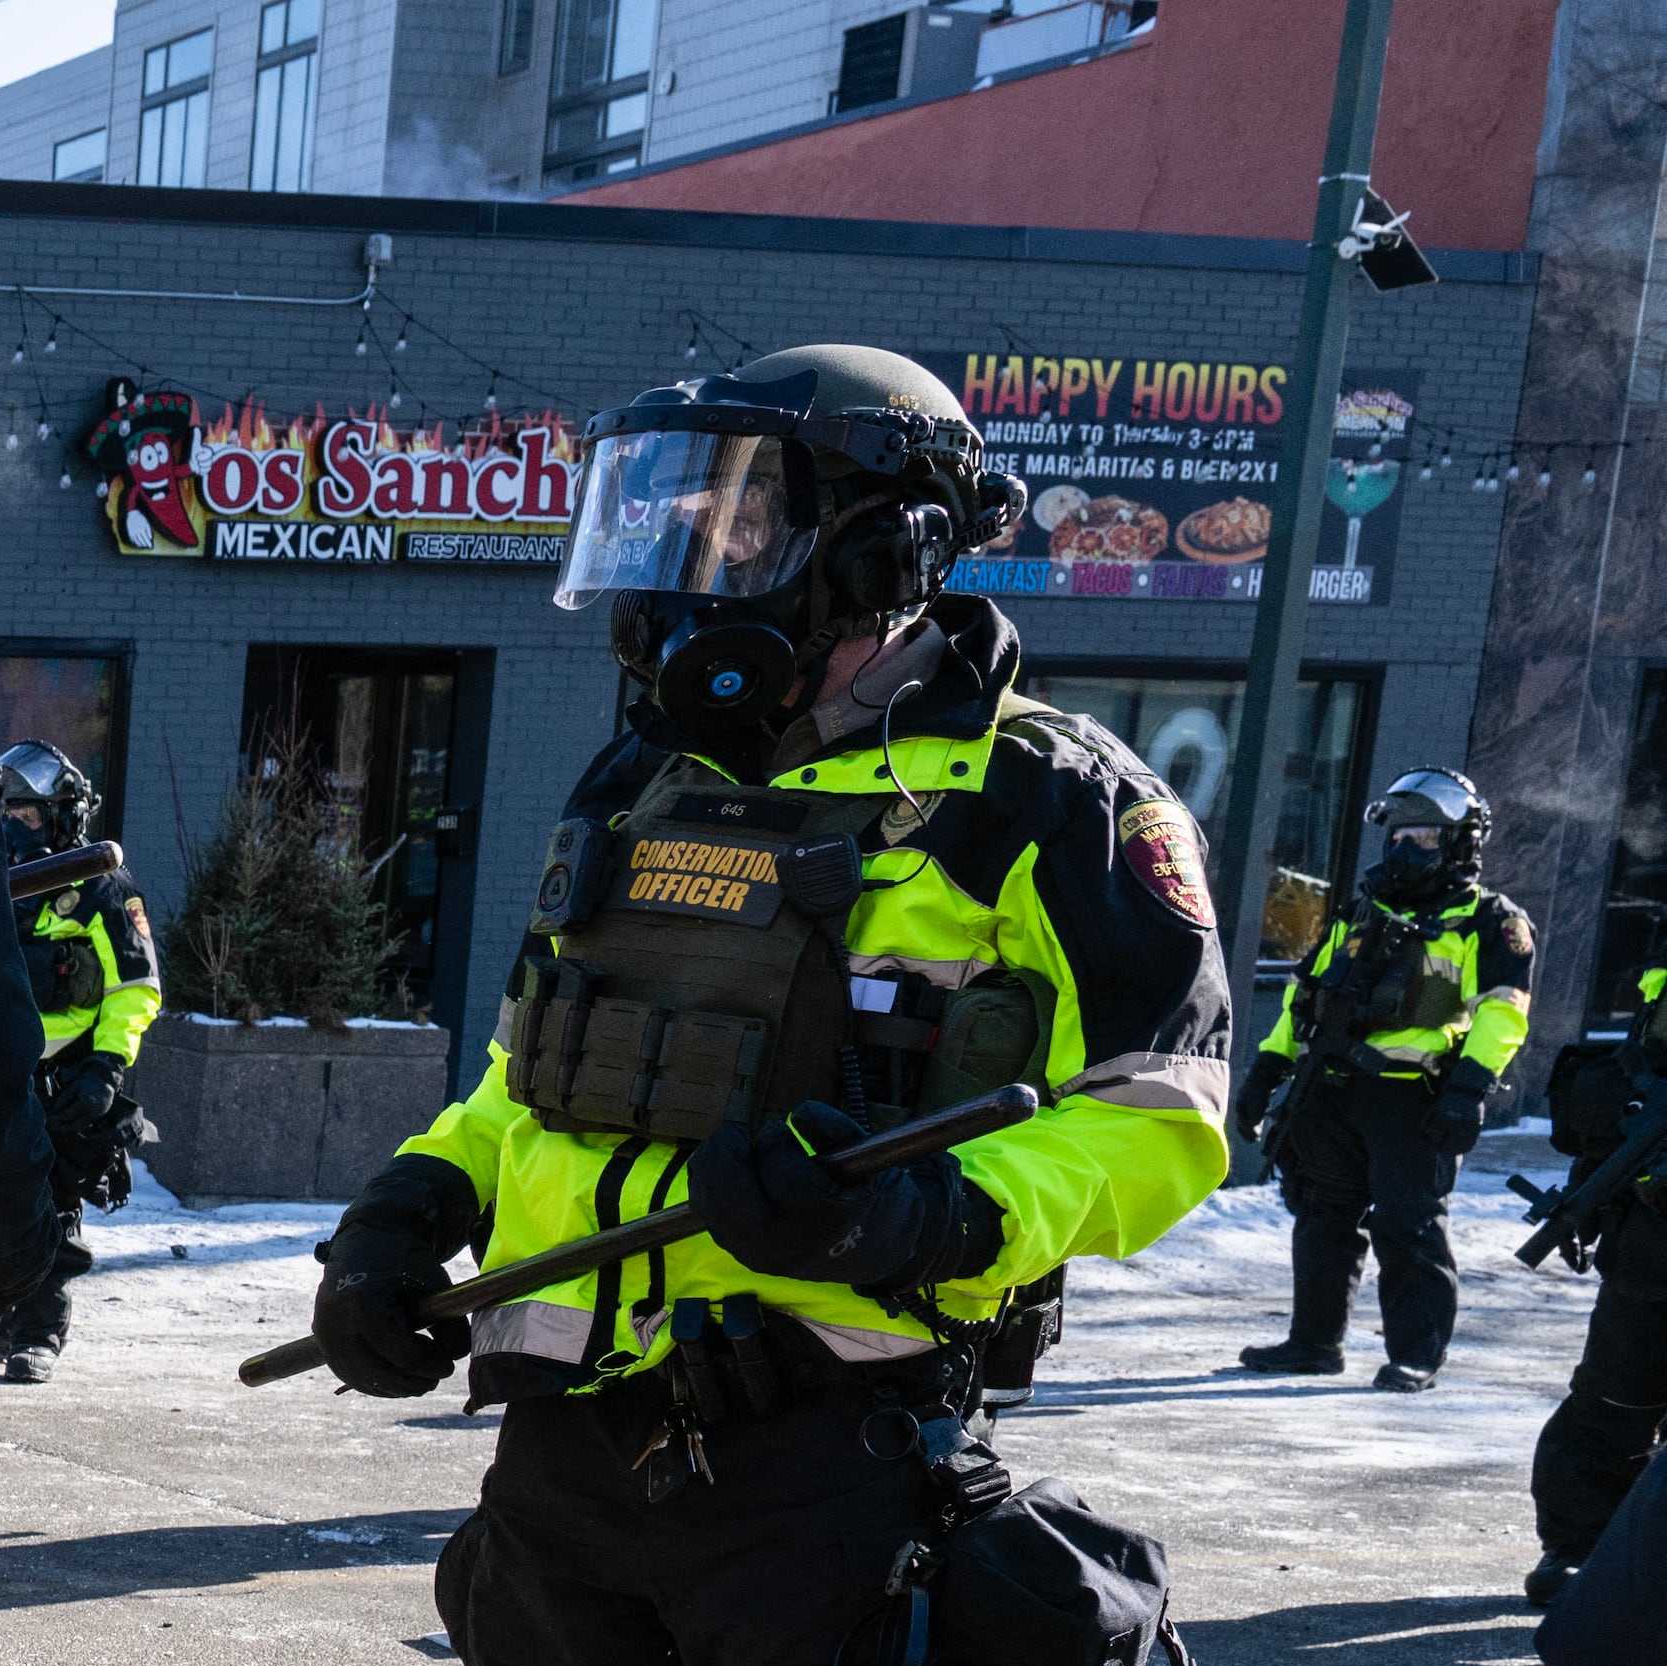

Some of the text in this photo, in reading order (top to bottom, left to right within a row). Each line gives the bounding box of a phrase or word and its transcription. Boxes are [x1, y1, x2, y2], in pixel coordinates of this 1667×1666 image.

[964, 354, 1287, 425] HAPPY HOURS
[985, 421, 1070, 446] MONDAY
[1080, 426, 1103, 447] TO
[318, 420, 575, 520] Sanch
[1161, 459, 1171, 480] &
[1237, 462, 1279, 484] 2X1
[214, 522, 393, 561] MEXICAN
[407, 533, 566, 561] RESTAURANT
[1071, 562, 1135, 595] TACOS
[1151, 563, 1229, 597] FAJITAS
[719, 802, 748, 818] 645
[630, 838, 780, 885] CONSERVATION
[628, 871, 752, 912] OFFICER
